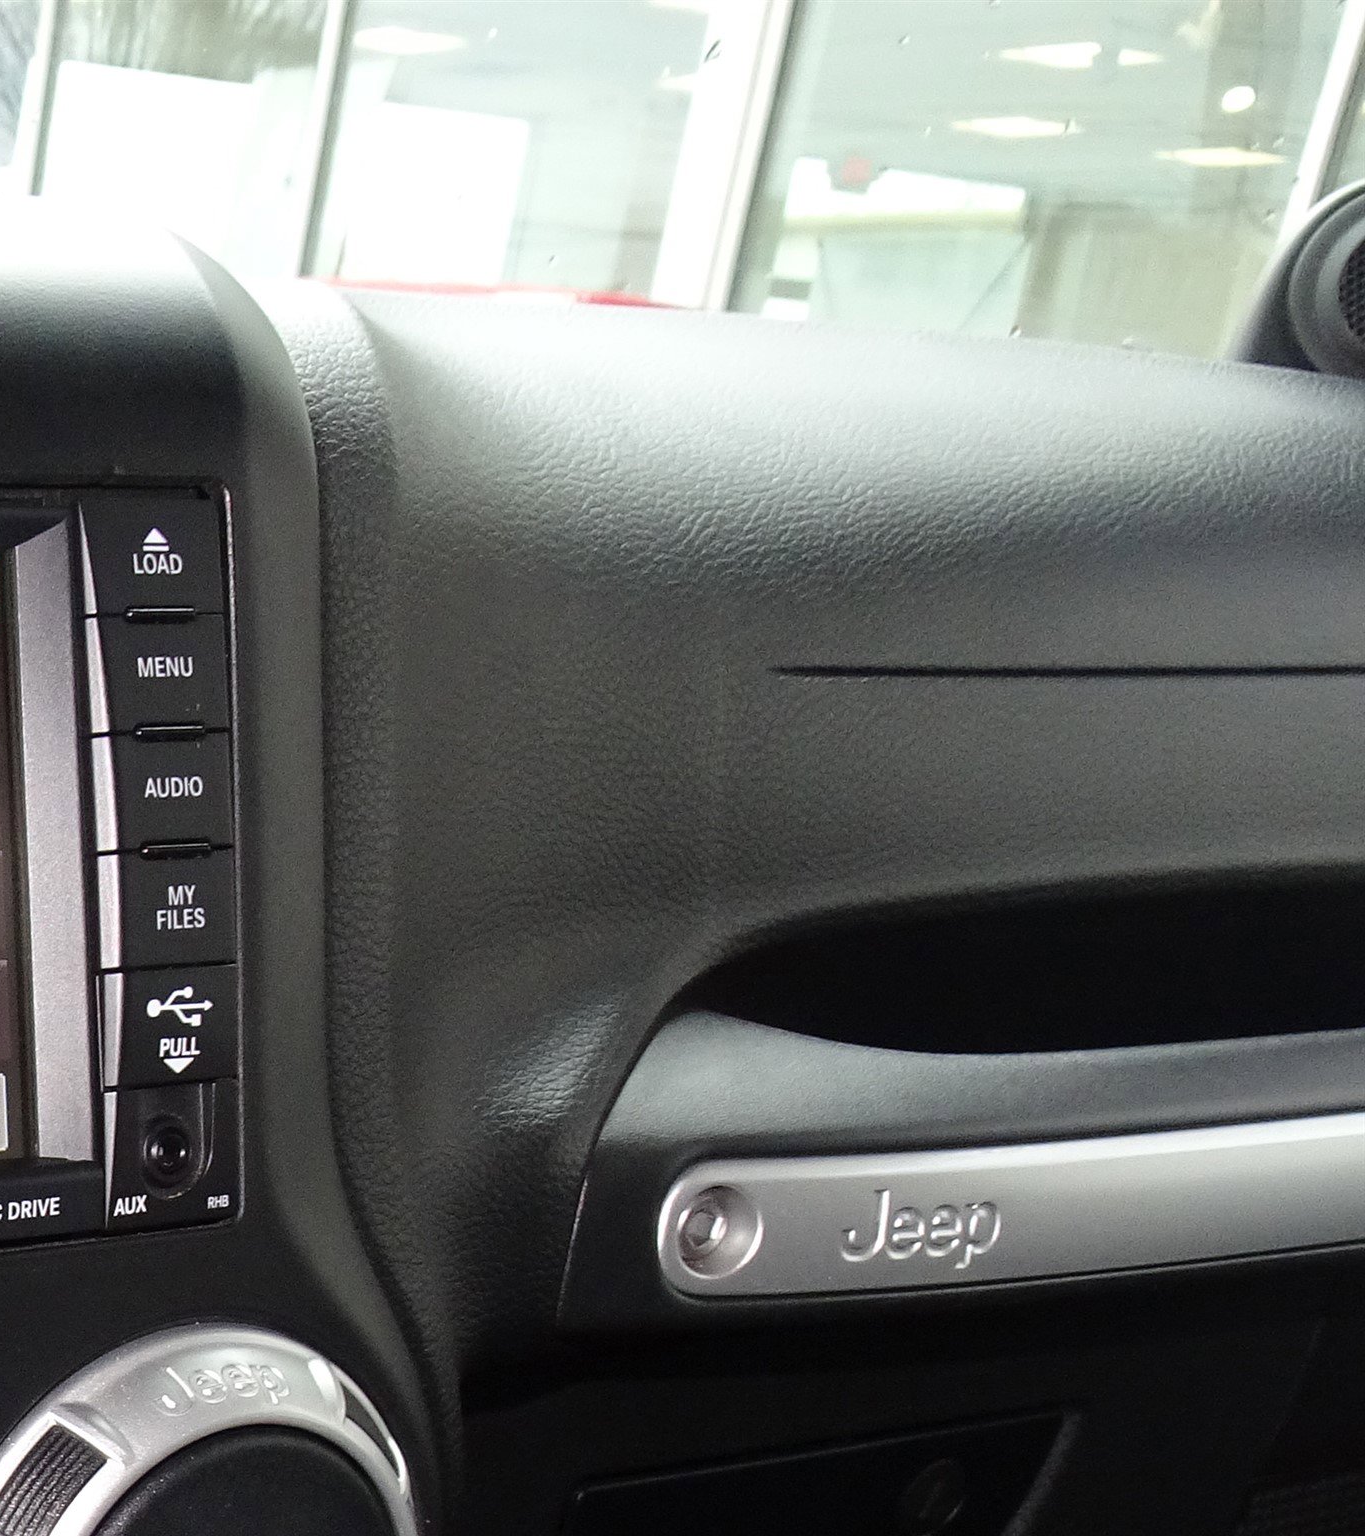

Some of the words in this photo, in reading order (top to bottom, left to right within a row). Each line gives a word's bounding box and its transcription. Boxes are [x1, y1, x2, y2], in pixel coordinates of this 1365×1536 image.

[131, 552, 183, 576] LOAD
[136, 656, 194, 679] MENU
[143, 776, 205, 799] AUDIO
[167, 884, 197, 907] MY
[155, 907, 207, 931] FILES
[158, 1036, 202, 1059] PULL
[7, 1195, 62, 1222] DRIVE
[112, 1194, 148, 1217] AUX
[841, 1189, 1002, 1269] Jeep
[153, 1362, 290, 1417] Jeep
